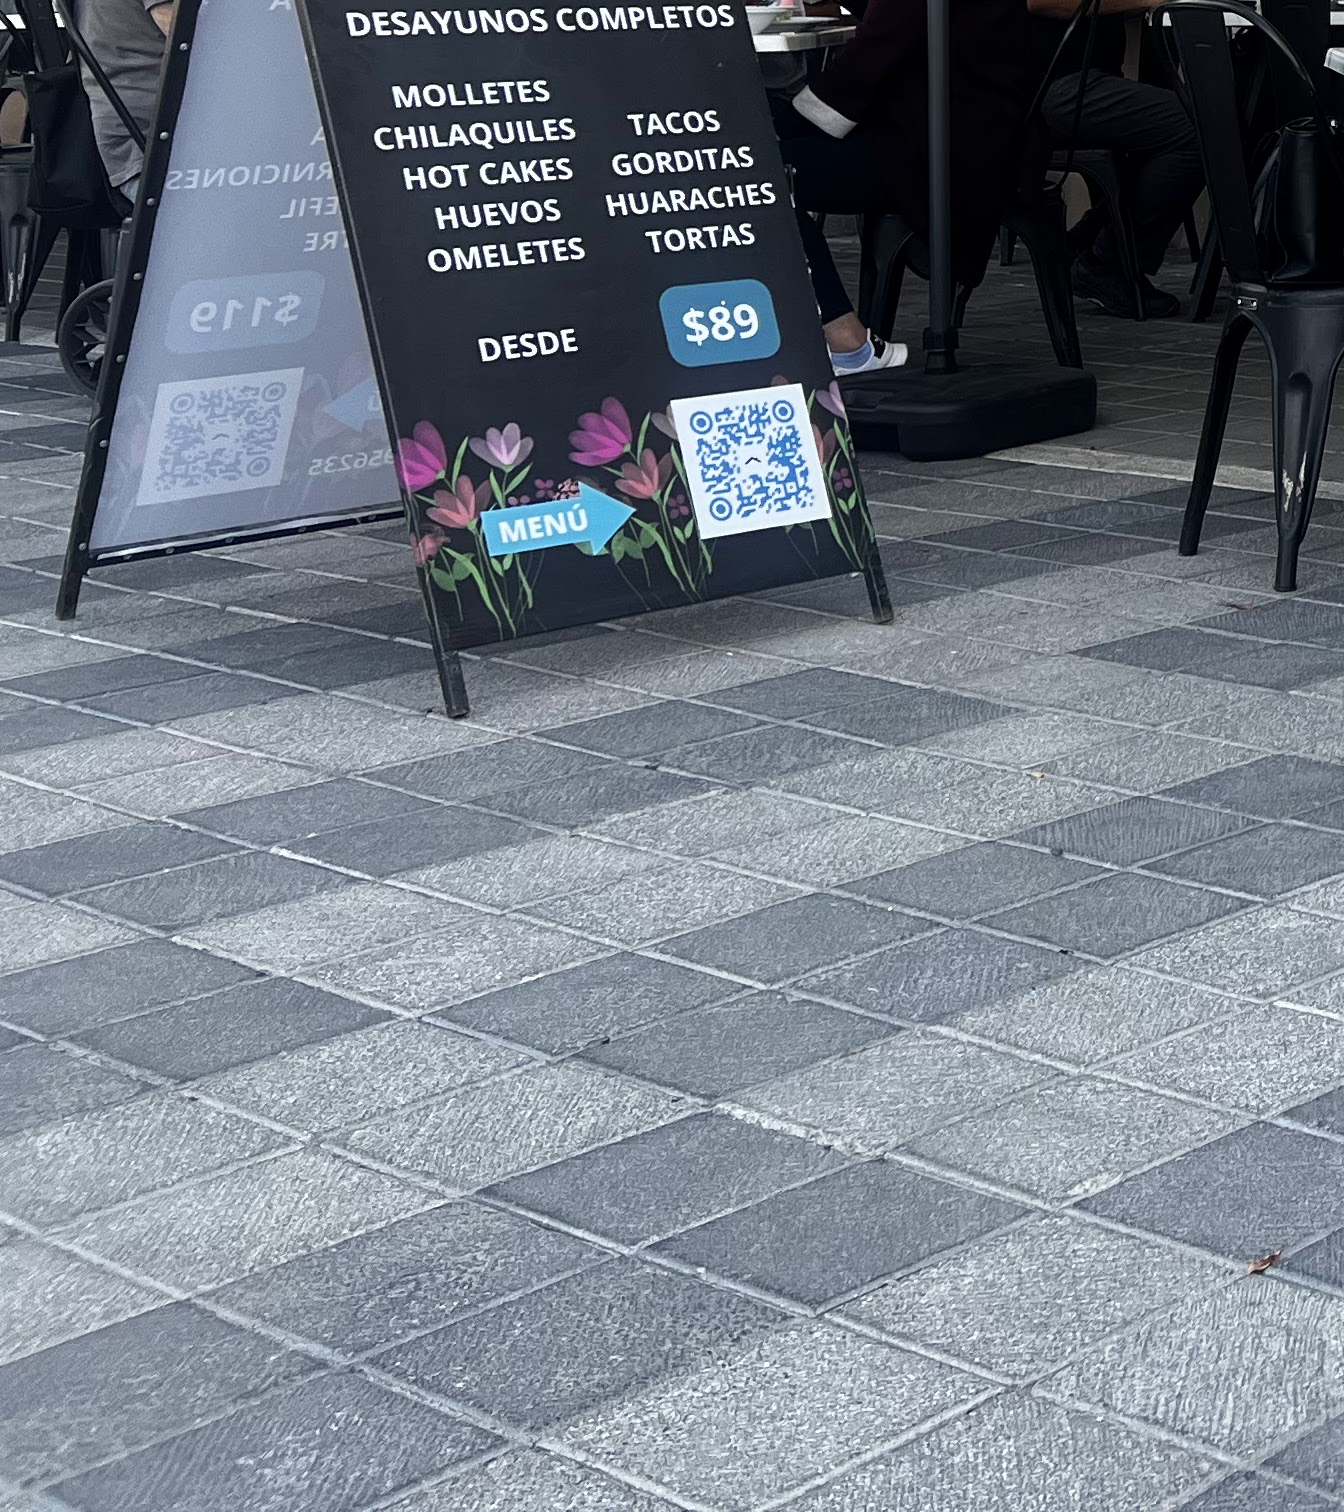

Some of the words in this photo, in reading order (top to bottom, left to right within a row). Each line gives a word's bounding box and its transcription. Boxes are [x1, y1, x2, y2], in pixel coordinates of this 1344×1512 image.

[346, 7, 549, 37] DESAYUNOS
[556, 4, 735, 33] COMPLETOS
[391, 79, 551, 109] MOLLETES
[373, 117, 577, 151] CHILAQUILES
[627, 109, 721, 137] TACOS
[402, 163, 470, 190] HOT
[479, 157, 574, 186] CAKES
[611, 146, 755, 177] GORDITAS
[434, 198, 561, 230] HUEVOS
[605, 182, 776, 217] HUARACHES
[427, 237, 586, 272] OMELETES
[645, 223, 756, 254] TORTAS
[682, 303, 759, 346] $89
[478, 328, 579, 362] DESDE
[498, 504, 588, 544] MENÚ
